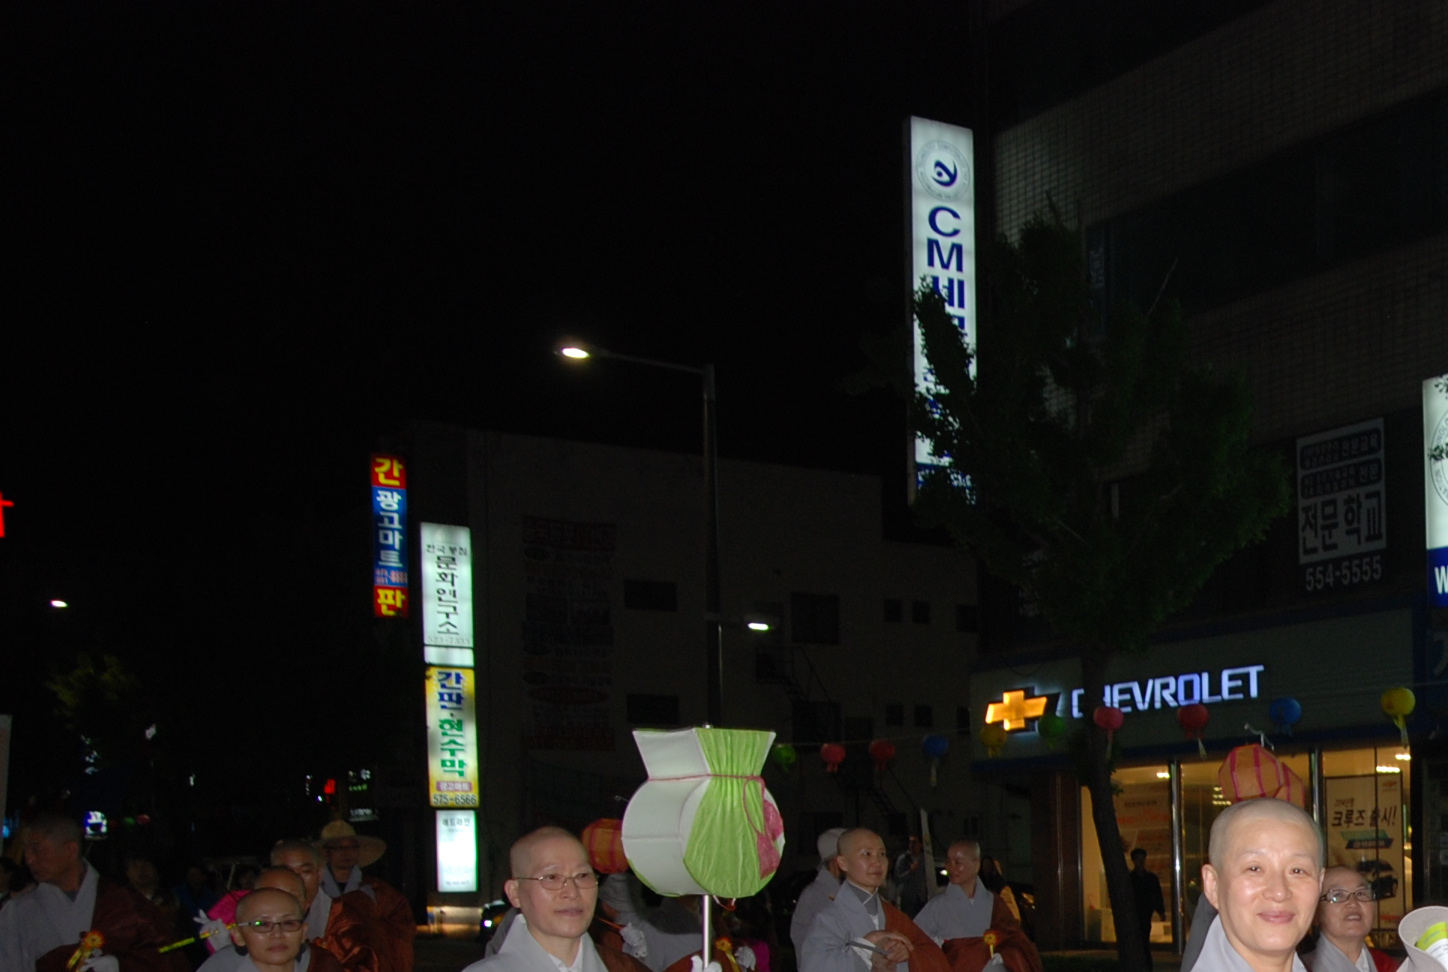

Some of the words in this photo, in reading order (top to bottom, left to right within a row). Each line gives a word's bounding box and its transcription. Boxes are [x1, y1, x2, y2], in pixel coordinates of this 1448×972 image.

[374, 457, 404, 487] 간
[376, 489, 403, 568] 광고마트
[1301, 491, 1383, 557] 전문학교
[1305, 555, 1383, 592] 554-5555
[376, 588, 406, 617] 판
[435, 555, 460, 636] 문화연구소
[1332, 808, 1366, 829] 크루즈
